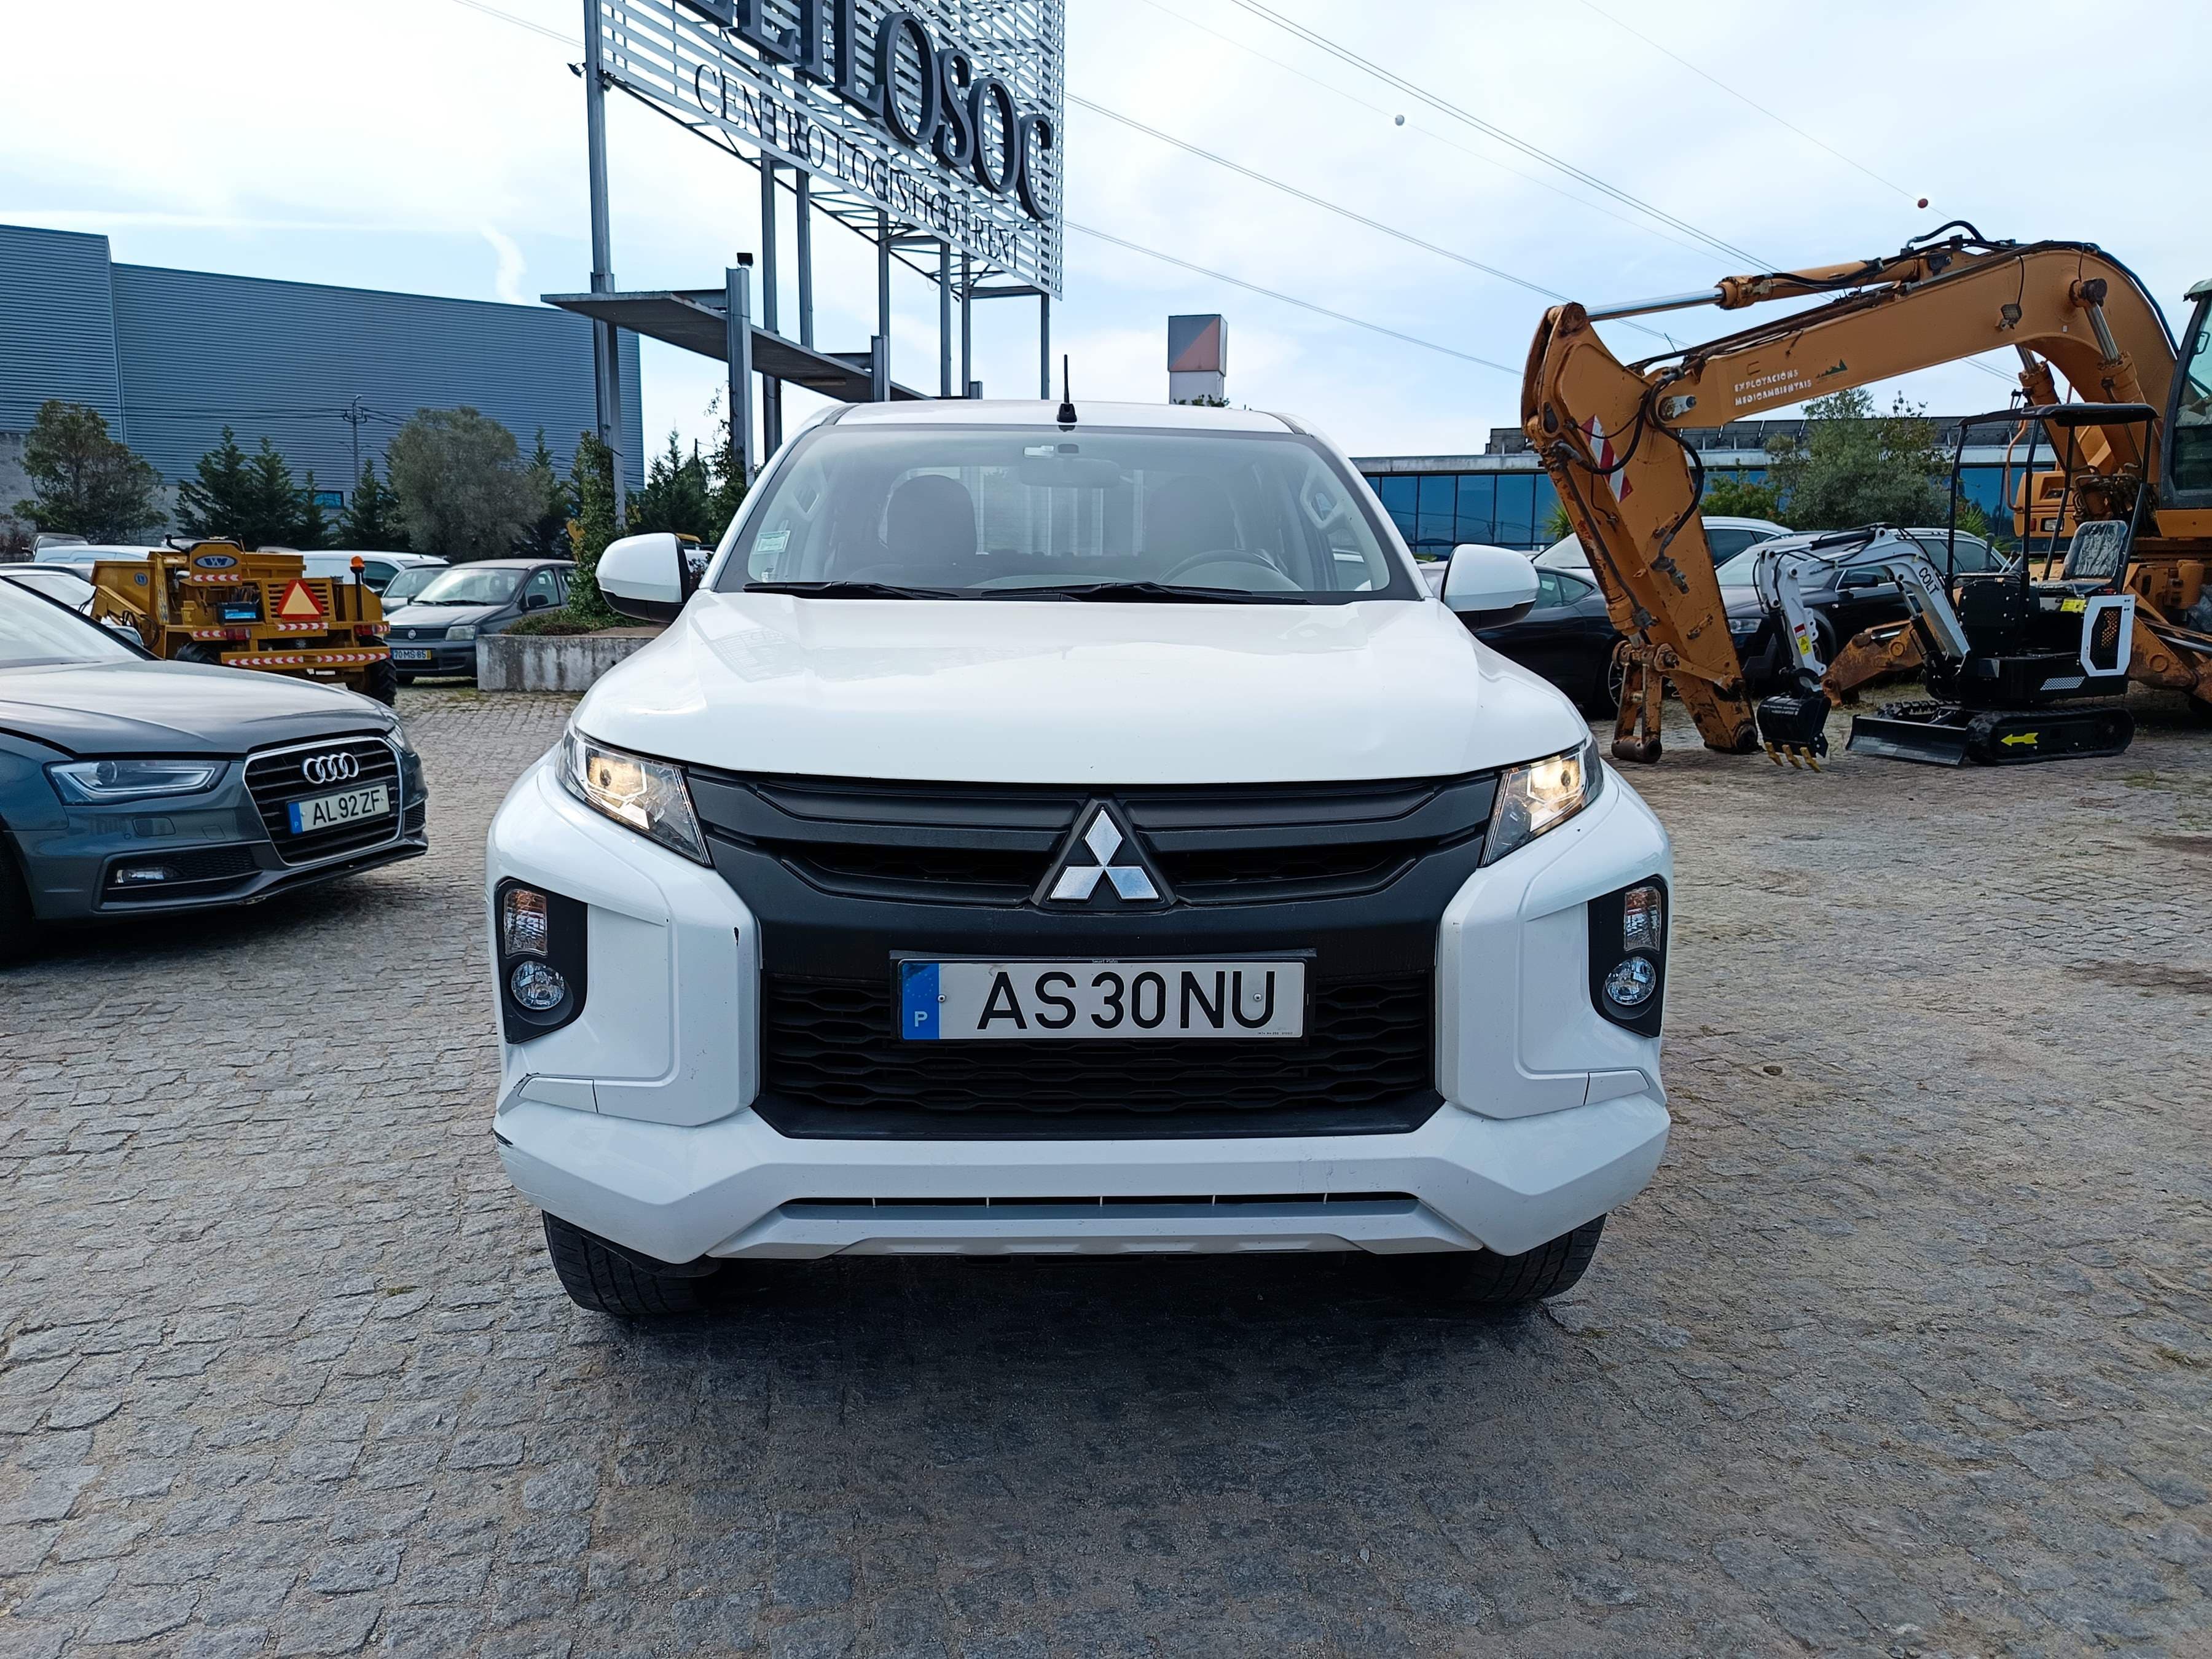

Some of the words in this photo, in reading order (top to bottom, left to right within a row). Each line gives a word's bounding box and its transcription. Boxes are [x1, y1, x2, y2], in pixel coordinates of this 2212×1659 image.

[673, 0, 1054, 221] ILOSOC
[695, 64, 825, 169] CENTRO
[974, 214, 1021, 270] RENT
[1919, 567, 1940, 595] COLT
[914, 1011, 928, 1027] P
